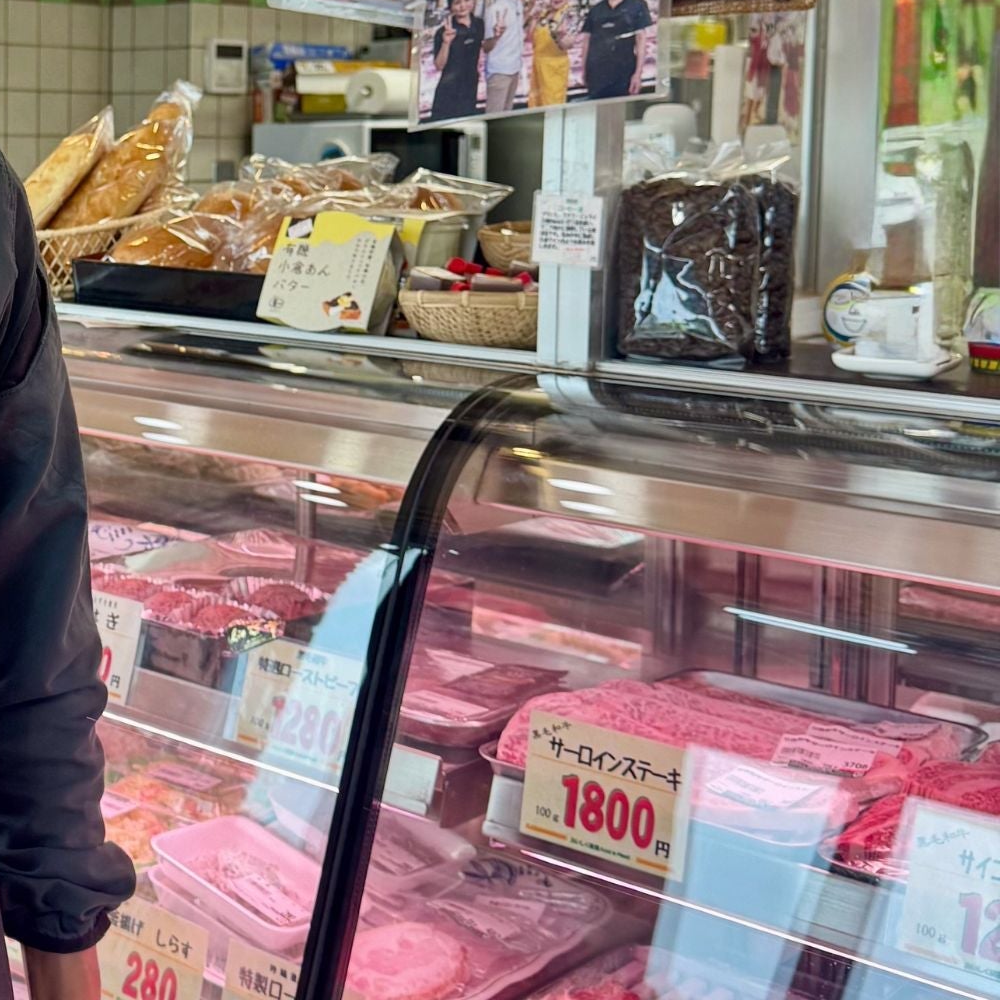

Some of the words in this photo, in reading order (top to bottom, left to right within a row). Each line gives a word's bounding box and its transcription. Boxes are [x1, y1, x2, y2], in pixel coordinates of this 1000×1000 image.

[272, 279, 310, 292] バター
[548, 735, 683, 792] サーロインステーキ
[561, 772, 655, 849] 1800
[654, 839, 671, 860] 円
[155, 928, 193, 959] しらす
[121, 950, 178, 1000] 280
